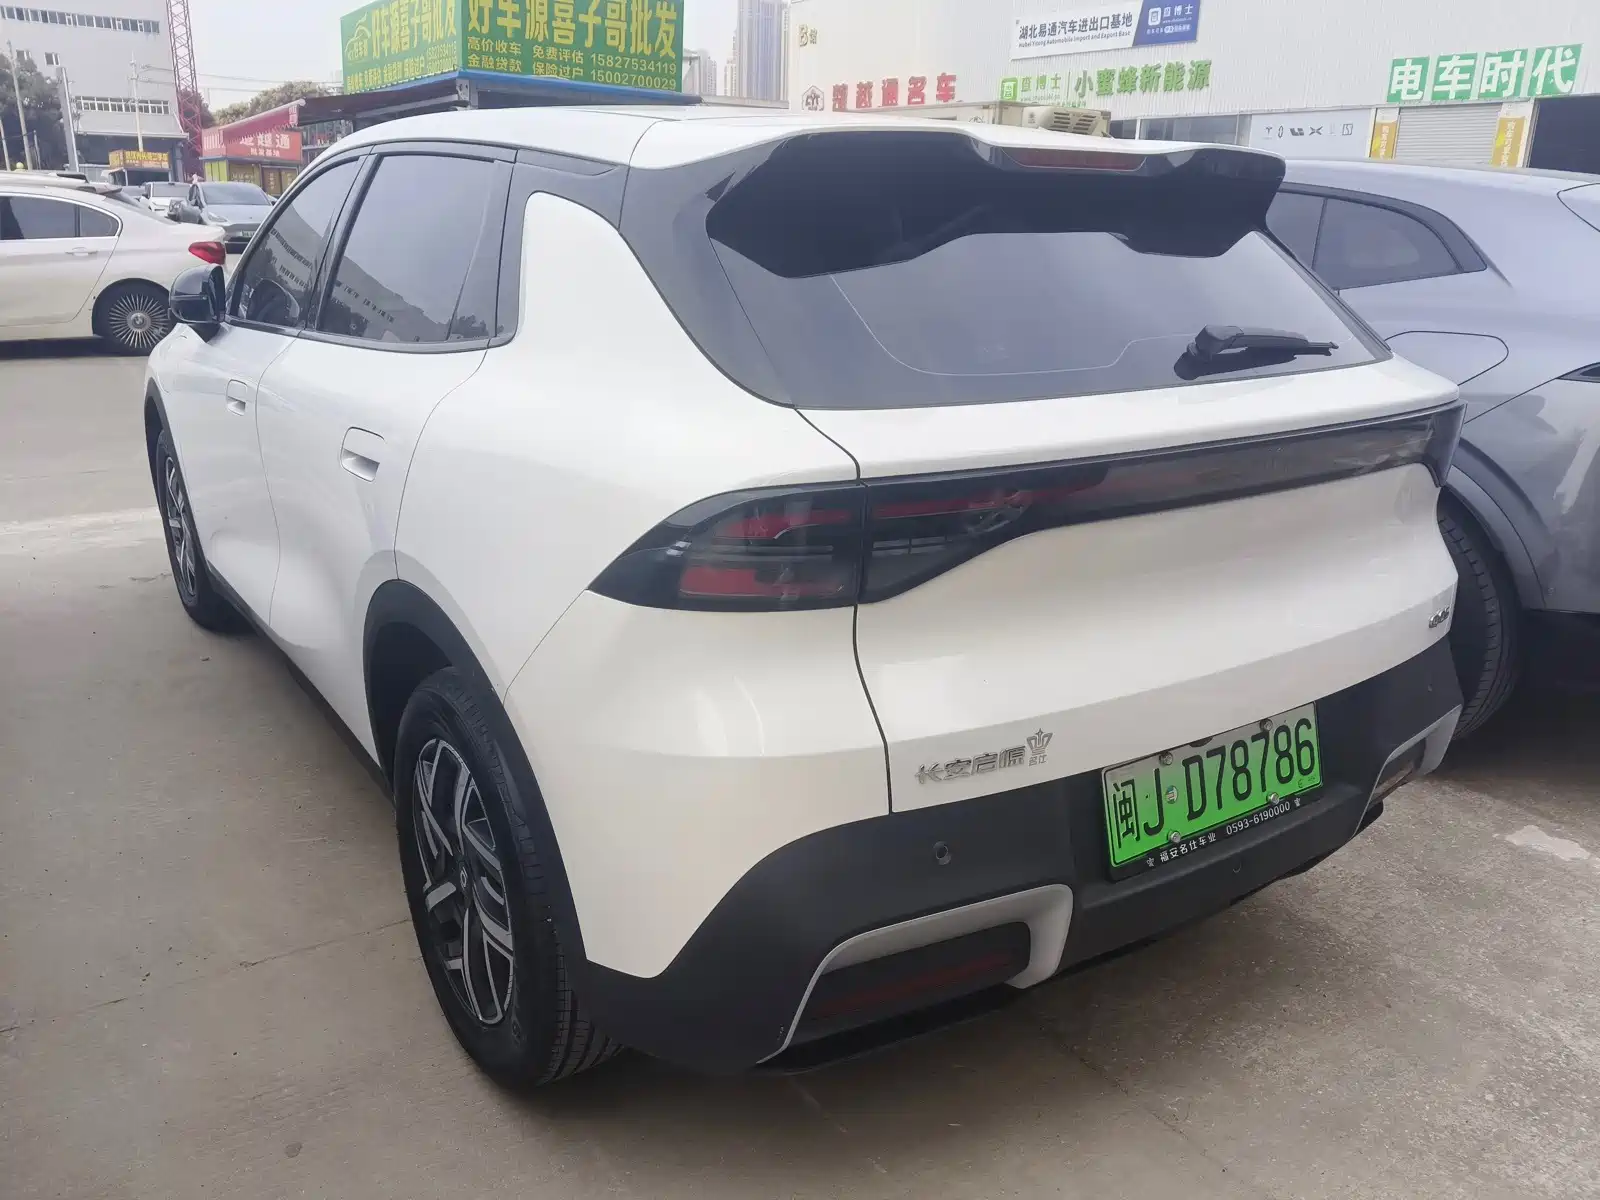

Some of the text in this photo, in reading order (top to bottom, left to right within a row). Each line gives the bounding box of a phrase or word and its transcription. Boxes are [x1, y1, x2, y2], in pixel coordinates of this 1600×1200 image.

[1018, 11, 1133, 40] 湖北易通汽车进出口基地
[467, 36, 522, 56] 高价收车
[532, 44, 584, 65] 免费评估
[590, 52, 677, 75] 15827534119
[467, 53, 522, 73] 金融贷款
[532, 61, 584, 79] 保险过户
[590, 68, 677, 91] 15002700029
[1389, 47, 1577, 101] 电车时代
[1021, 59, 1212, 98] 查博士 小蜜蜂新能源
[915, 745, 1026, 784] 长安启源
[1160, 801, 1291, 863] 福安名仕车业 0593-6190000
